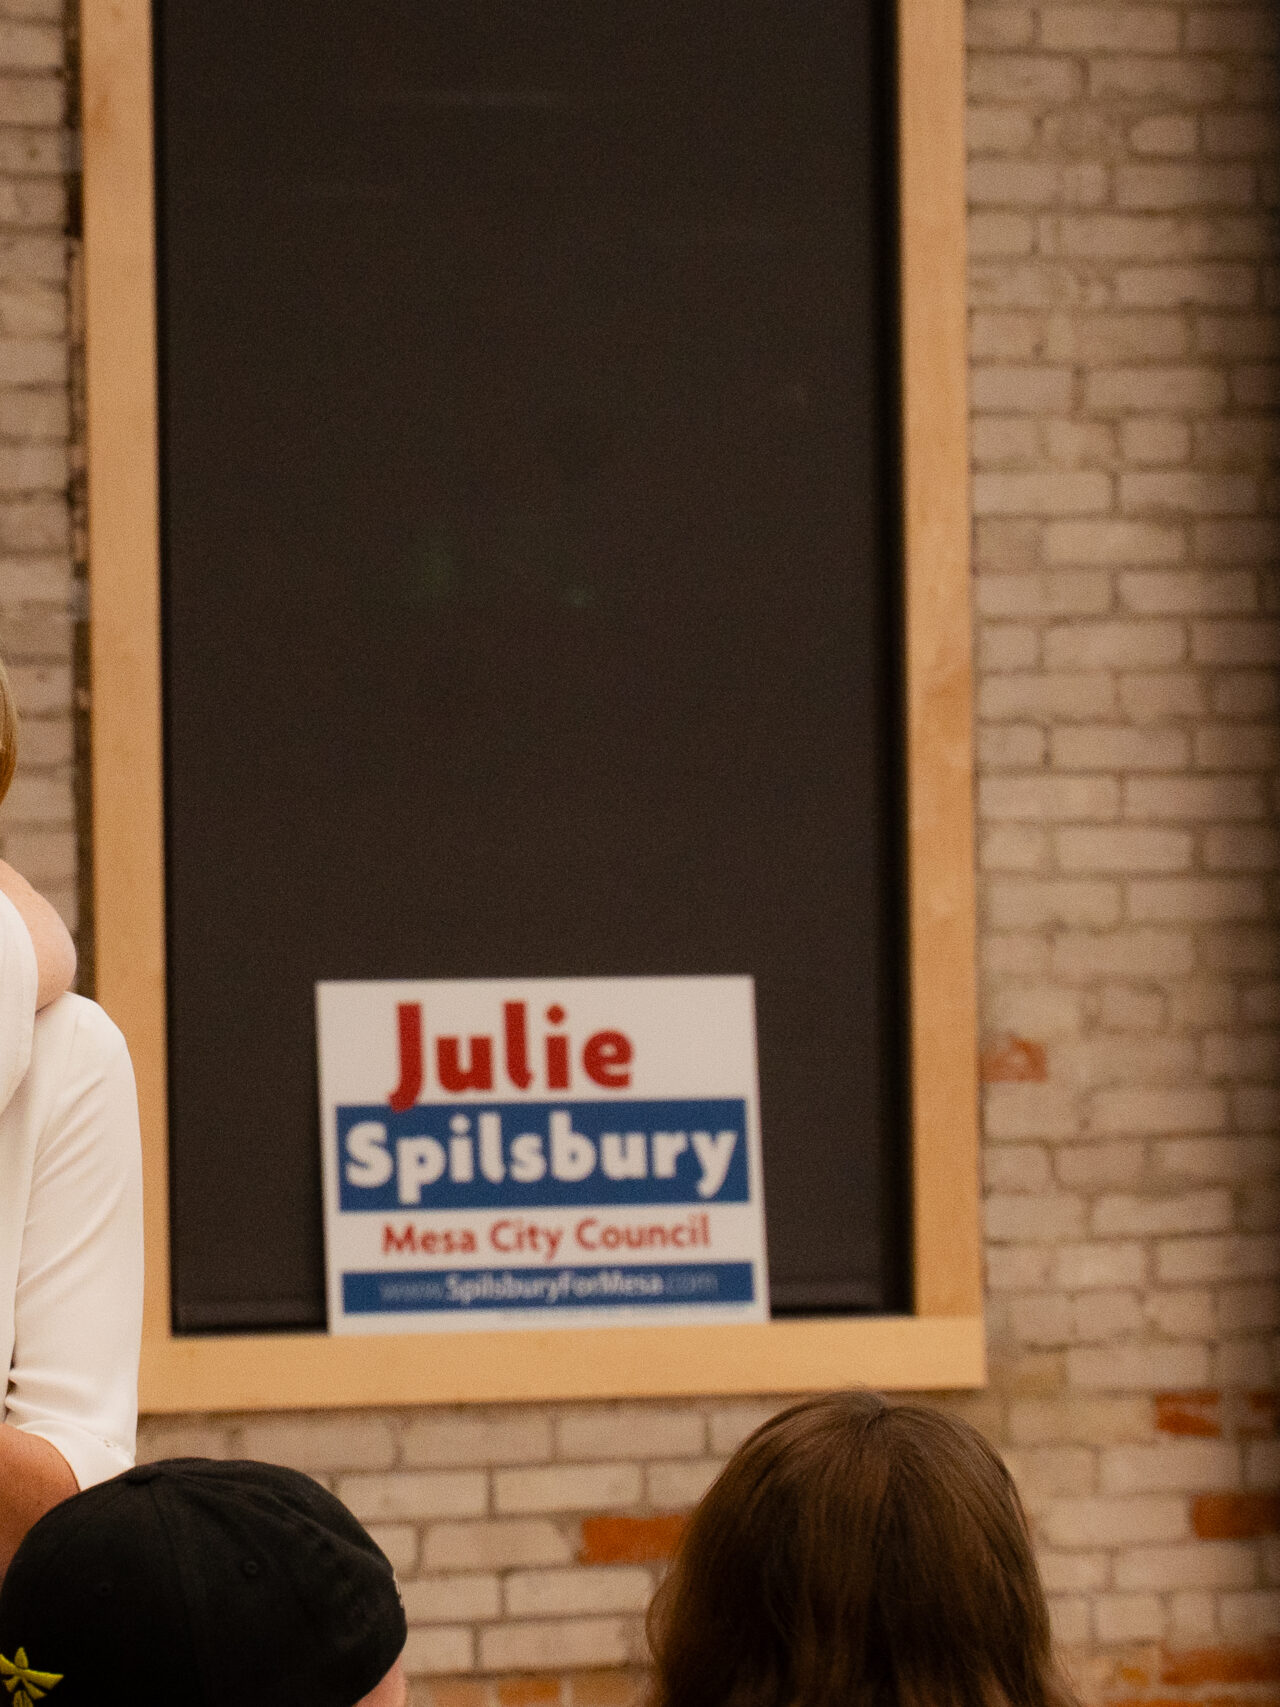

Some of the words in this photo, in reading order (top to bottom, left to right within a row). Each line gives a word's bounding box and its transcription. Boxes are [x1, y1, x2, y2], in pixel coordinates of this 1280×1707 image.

[388, 1000, 634, 1112] Julie
[345, 1110, 738, 1204] Spilsbury
[381, 1222, 478, 1256] Mesa
[489, 1219, 563, 1261] City
[574, 1213, 711, 1250] Council
